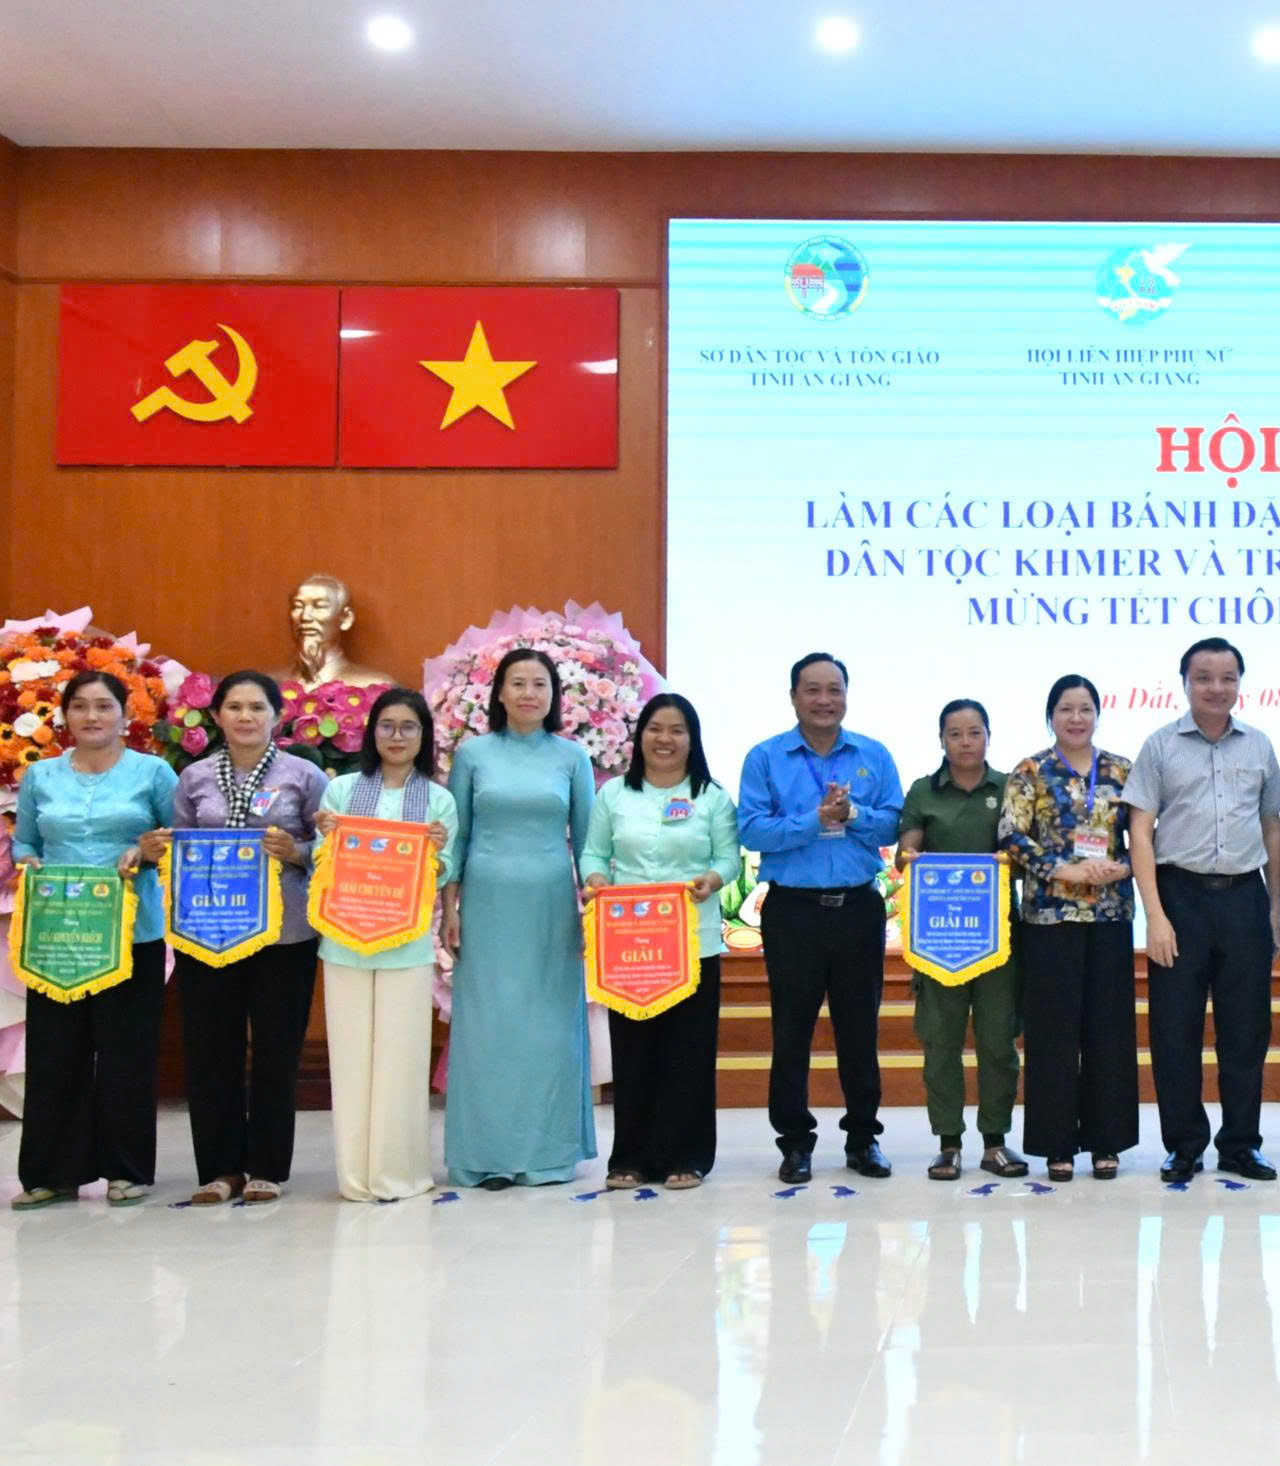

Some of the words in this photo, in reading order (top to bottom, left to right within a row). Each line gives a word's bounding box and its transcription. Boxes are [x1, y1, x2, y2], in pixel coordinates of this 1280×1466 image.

[799, 373, 826, 386] AN
[830, 372, 891, 386] GIANG
[1111, 372, 1135, 385] AN
[1140, 372, 1200, 385] GIANG
[1155, 413, 1280, 489] HỘI
[805, 491, 892, 528] LÀM
[906, 491, 988, 528] CÁC
[1001, 500, 1095, 536] LOẠI
[1111, 491, 1217, 528] BÁNH
[826, 539, 905, 577] DÂN
[919, 543, 1001, 584] TỘC
[1014, 548, 1163, 577] KHMER
[1174, 539, 1229, 577] VÀ
[968, 588, 1090, 625] MỪNG
[1102, 587, 1178, 625] TẾT
[230, 893, 247, 907] III
[929, 911, 960, 928] GIẢI
[963, 916, 979, 928] III
